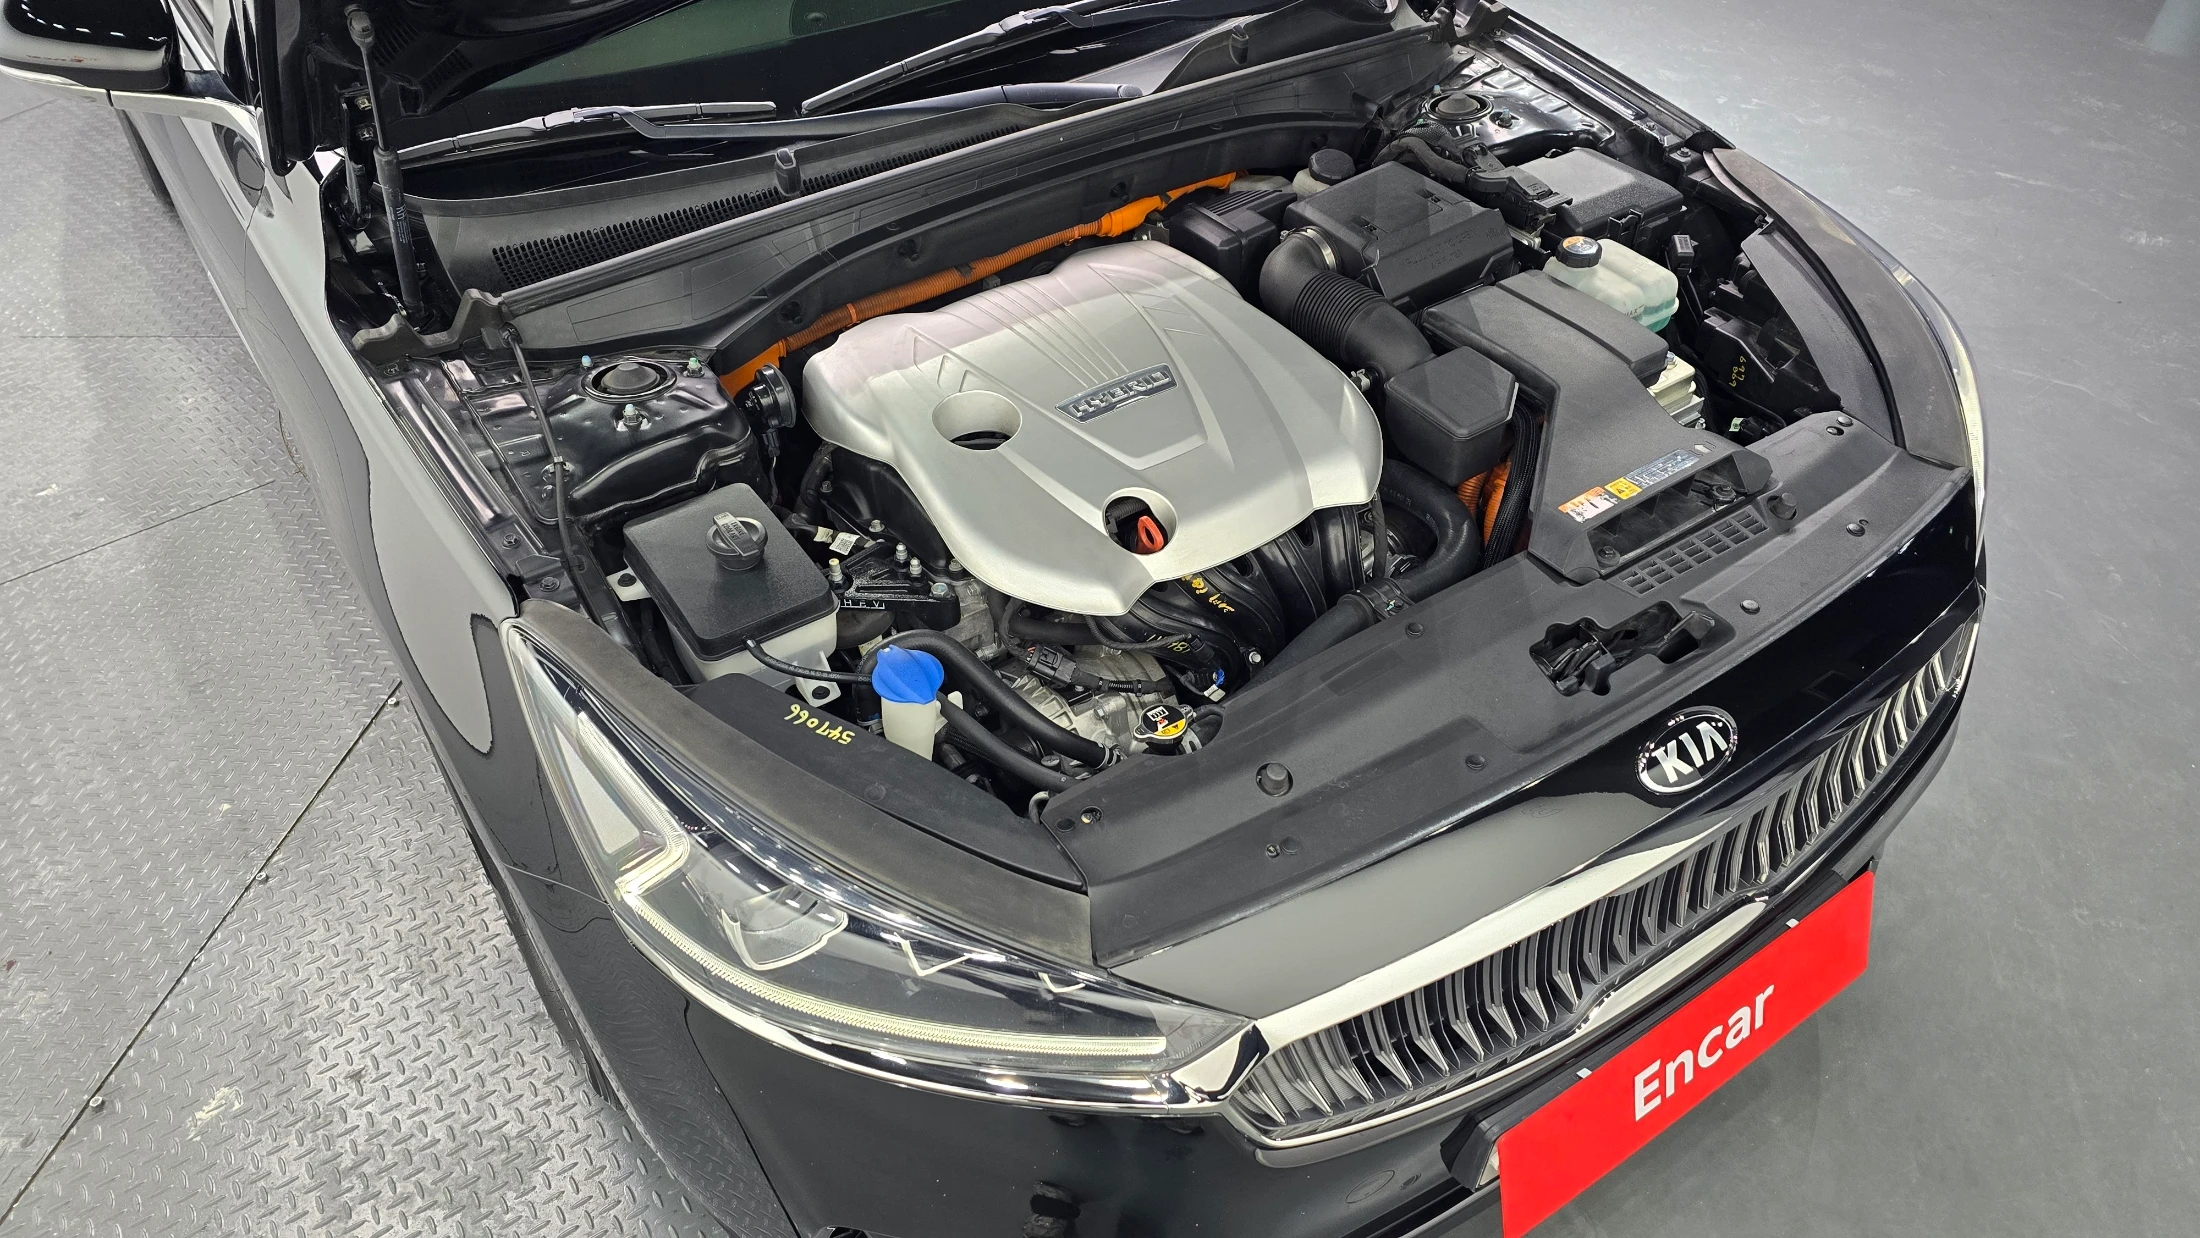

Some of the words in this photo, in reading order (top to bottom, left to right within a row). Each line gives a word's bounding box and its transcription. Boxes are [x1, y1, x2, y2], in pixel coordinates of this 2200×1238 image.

[1068, 371, 1171, 418] HYBRID
[783, 703, 856, 745] 547066
[1651, 721, 1728, 784] KIA
[1634, 984, 1775, 1122] Encar
